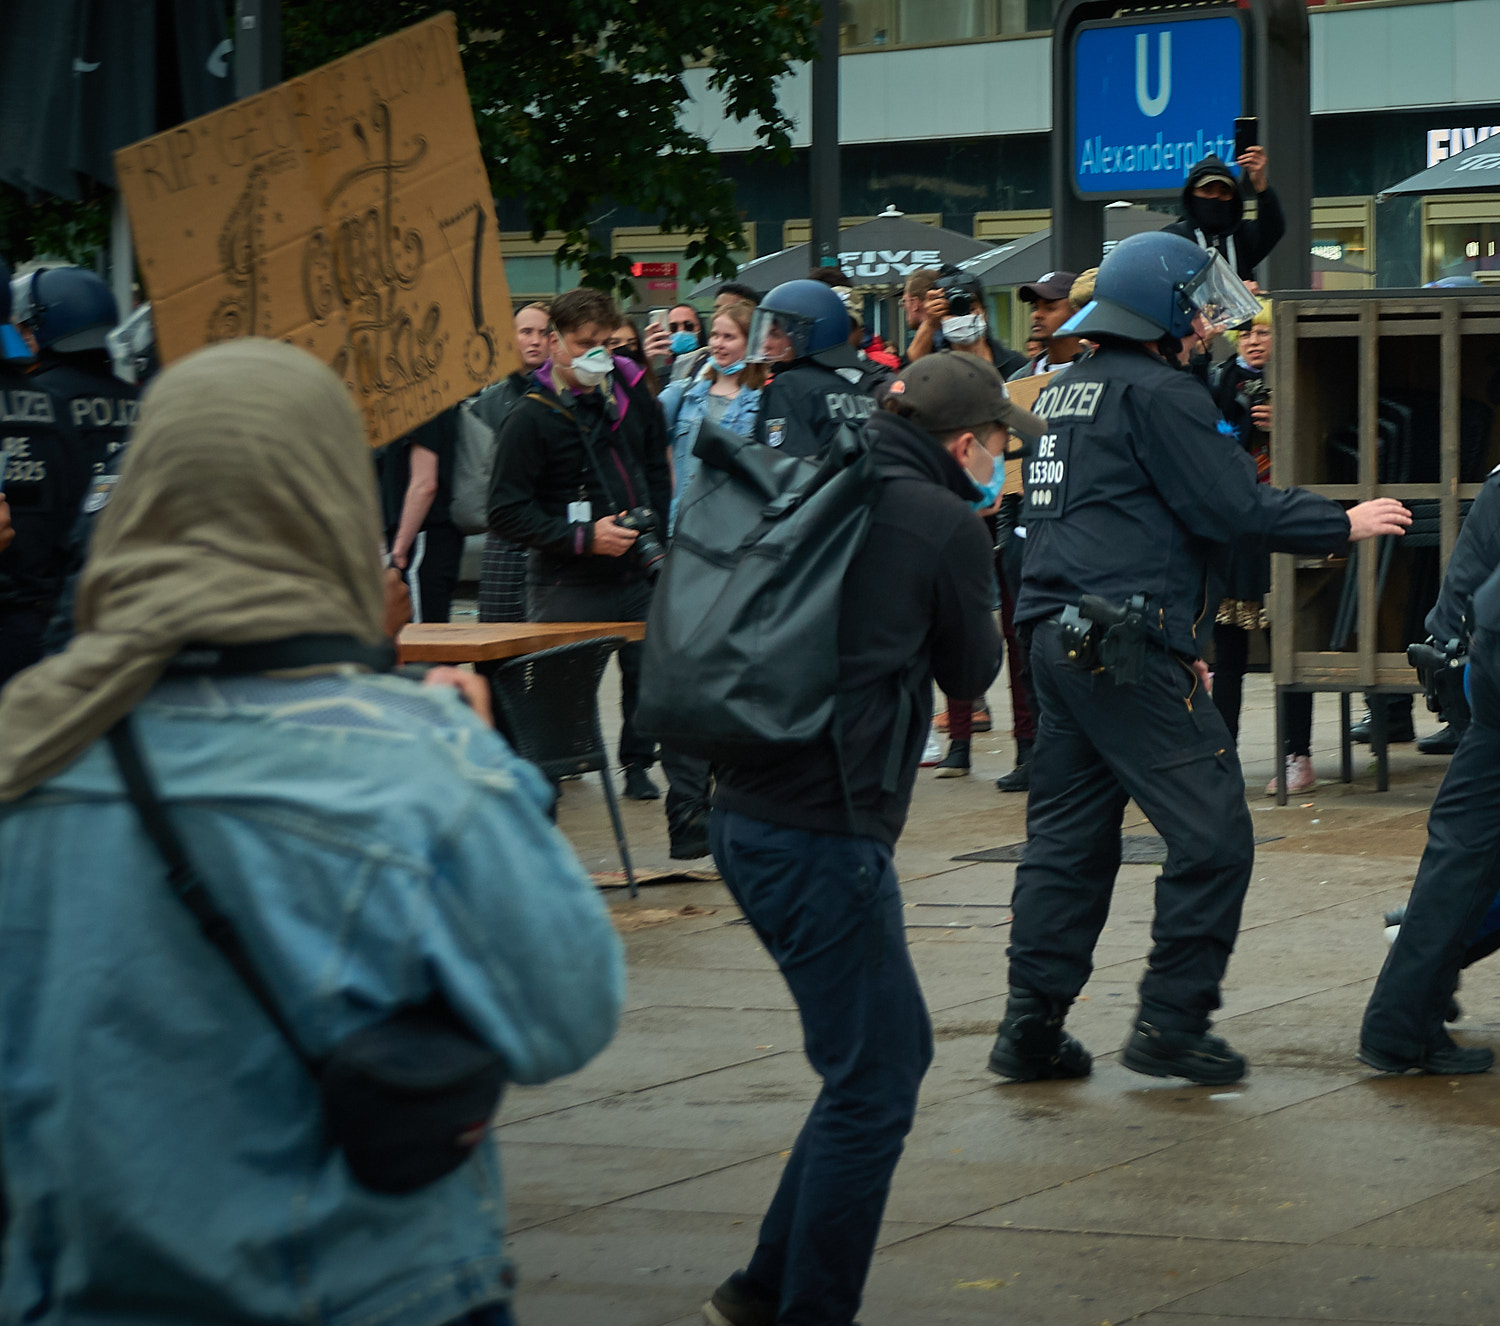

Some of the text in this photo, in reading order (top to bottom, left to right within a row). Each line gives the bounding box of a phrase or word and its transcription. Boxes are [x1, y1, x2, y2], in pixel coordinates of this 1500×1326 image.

[1135, 31, 1172, 117] U
[138, 128, 199, 200] RIP
[837, 249, 941, 266] FIVE
[1031, 382, 1104, 419] POLIZEI
[1038, 434, 1058, 458] BE
[1028, 460, 1064, 484] 15300
